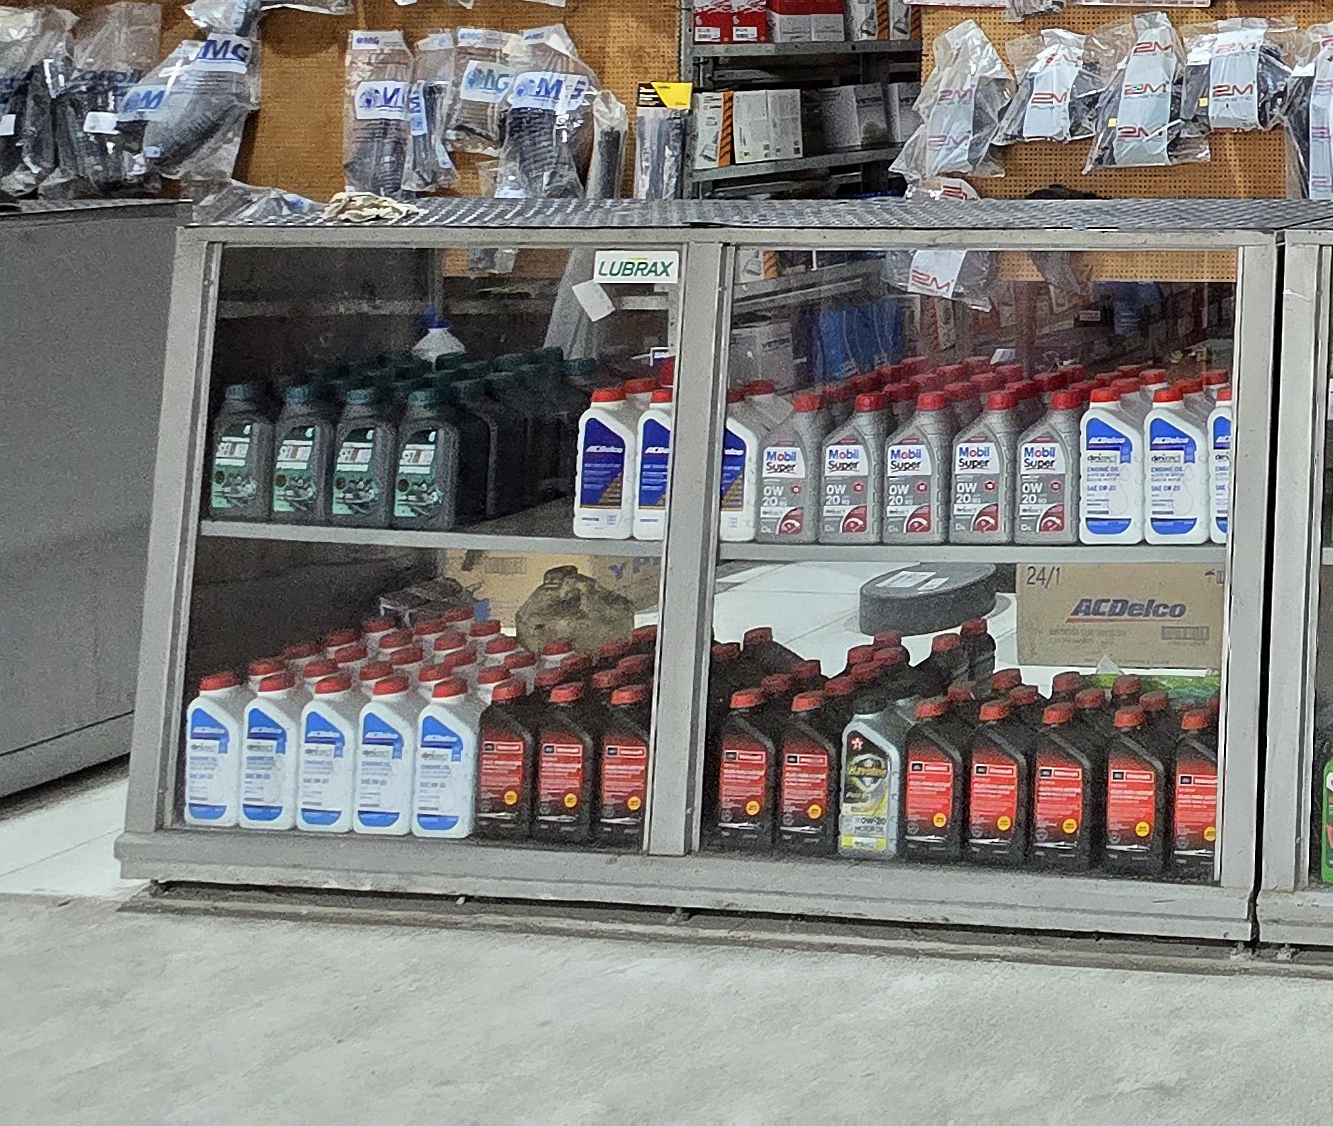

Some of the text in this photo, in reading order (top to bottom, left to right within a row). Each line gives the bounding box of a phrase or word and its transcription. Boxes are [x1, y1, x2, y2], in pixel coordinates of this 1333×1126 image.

[1212, 84, 1253, 97] 2M
[598, 260, 674, 277] LUBRAX
[766, 451, 797, 462] Mobil
[828, 449, 859, 460] Mobil
[890, 449, 922, 460] Mobil
[958, 446, 990, 457] Mobil
[1023, 446, 1056, 457] Mobil
[765, 462, 796, 473] Super
[828, 460, 860, 472] Super
[890, 460, 923, 472] Super
[958, 458, 990, 470] Super
[1023, 458, 1056, 470] Super
[763, 485, 785, 496] 0W
[826, 484, 847, 495] 0W
[889, 484, 910, 495] 0W
[956, 482, 978, 493] 0W
[1022, 482, 1043, 493] 0W
[762, 497, 778, 507] 20
[825, 495, 841, 506] 20
[888, 495, 904, 506] 20
[955, 494, 971, 504] 20
[1021, 493, 1038, 504] 20
[1026, 565, 1061, 588] 24/1
[1070, 598, 1187, 619] ACDelco
